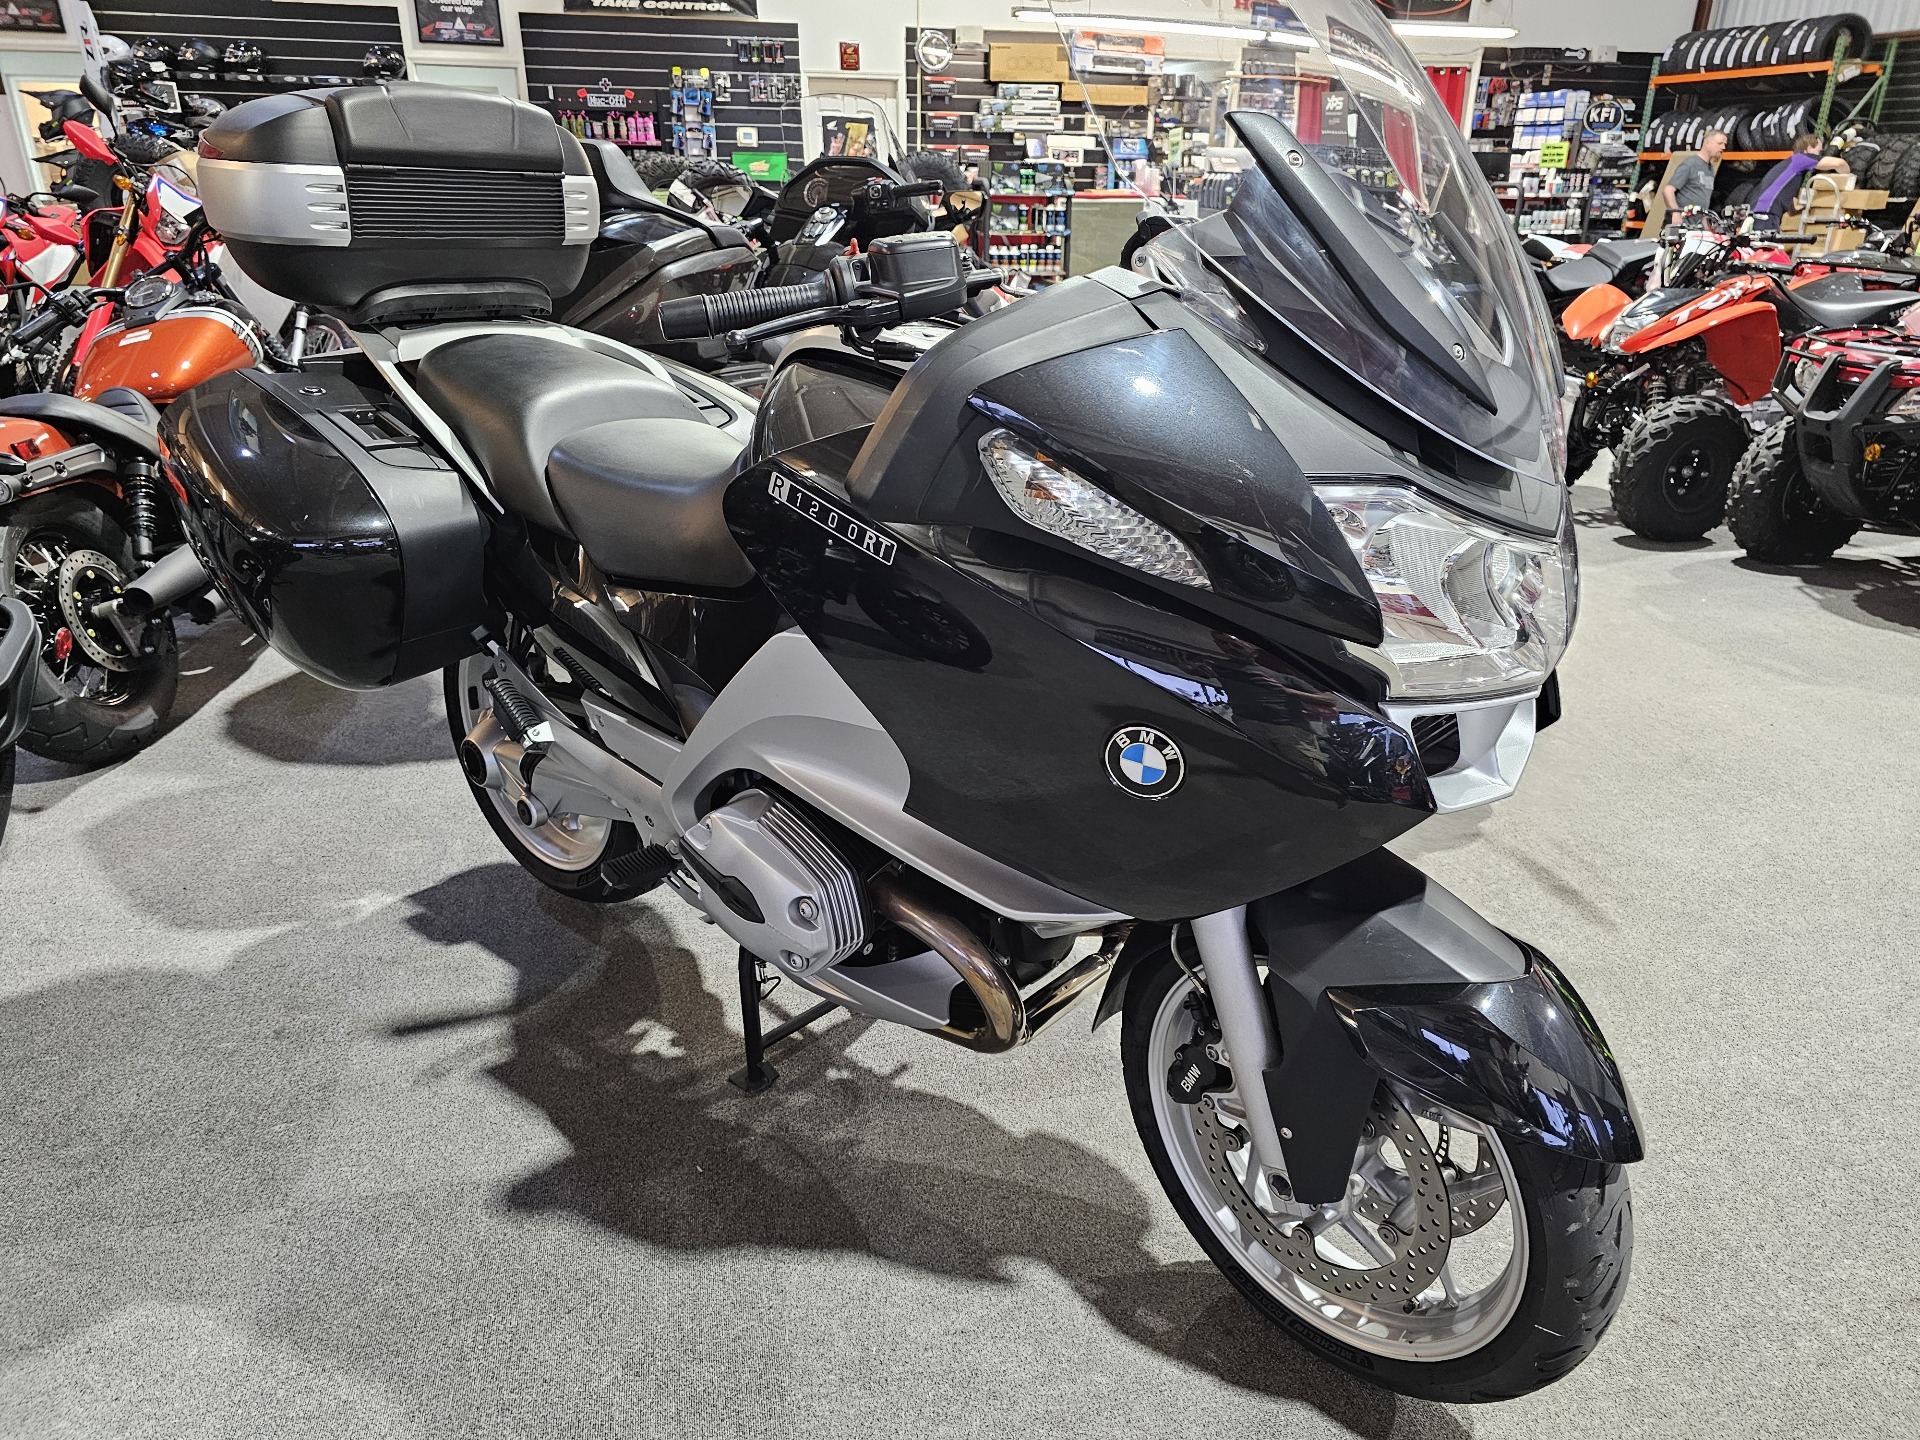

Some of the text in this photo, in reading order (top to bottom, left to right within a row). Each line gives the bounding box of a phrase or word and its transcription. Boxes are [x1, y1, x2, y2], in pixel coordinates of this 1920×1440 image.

[643, 0, 731, 11] CONTROL
[590, 96, 624, 105] Muc-Off
[1589, 107, 1616, 122] KFI
[1115, 730, 1178, 760] BMW
[1180, 1063, 1201, 1093] BMW
[1255, 1291, 1285, 1318] ROAD
[1294, 1322, 1352, 1361] MICHELIN
